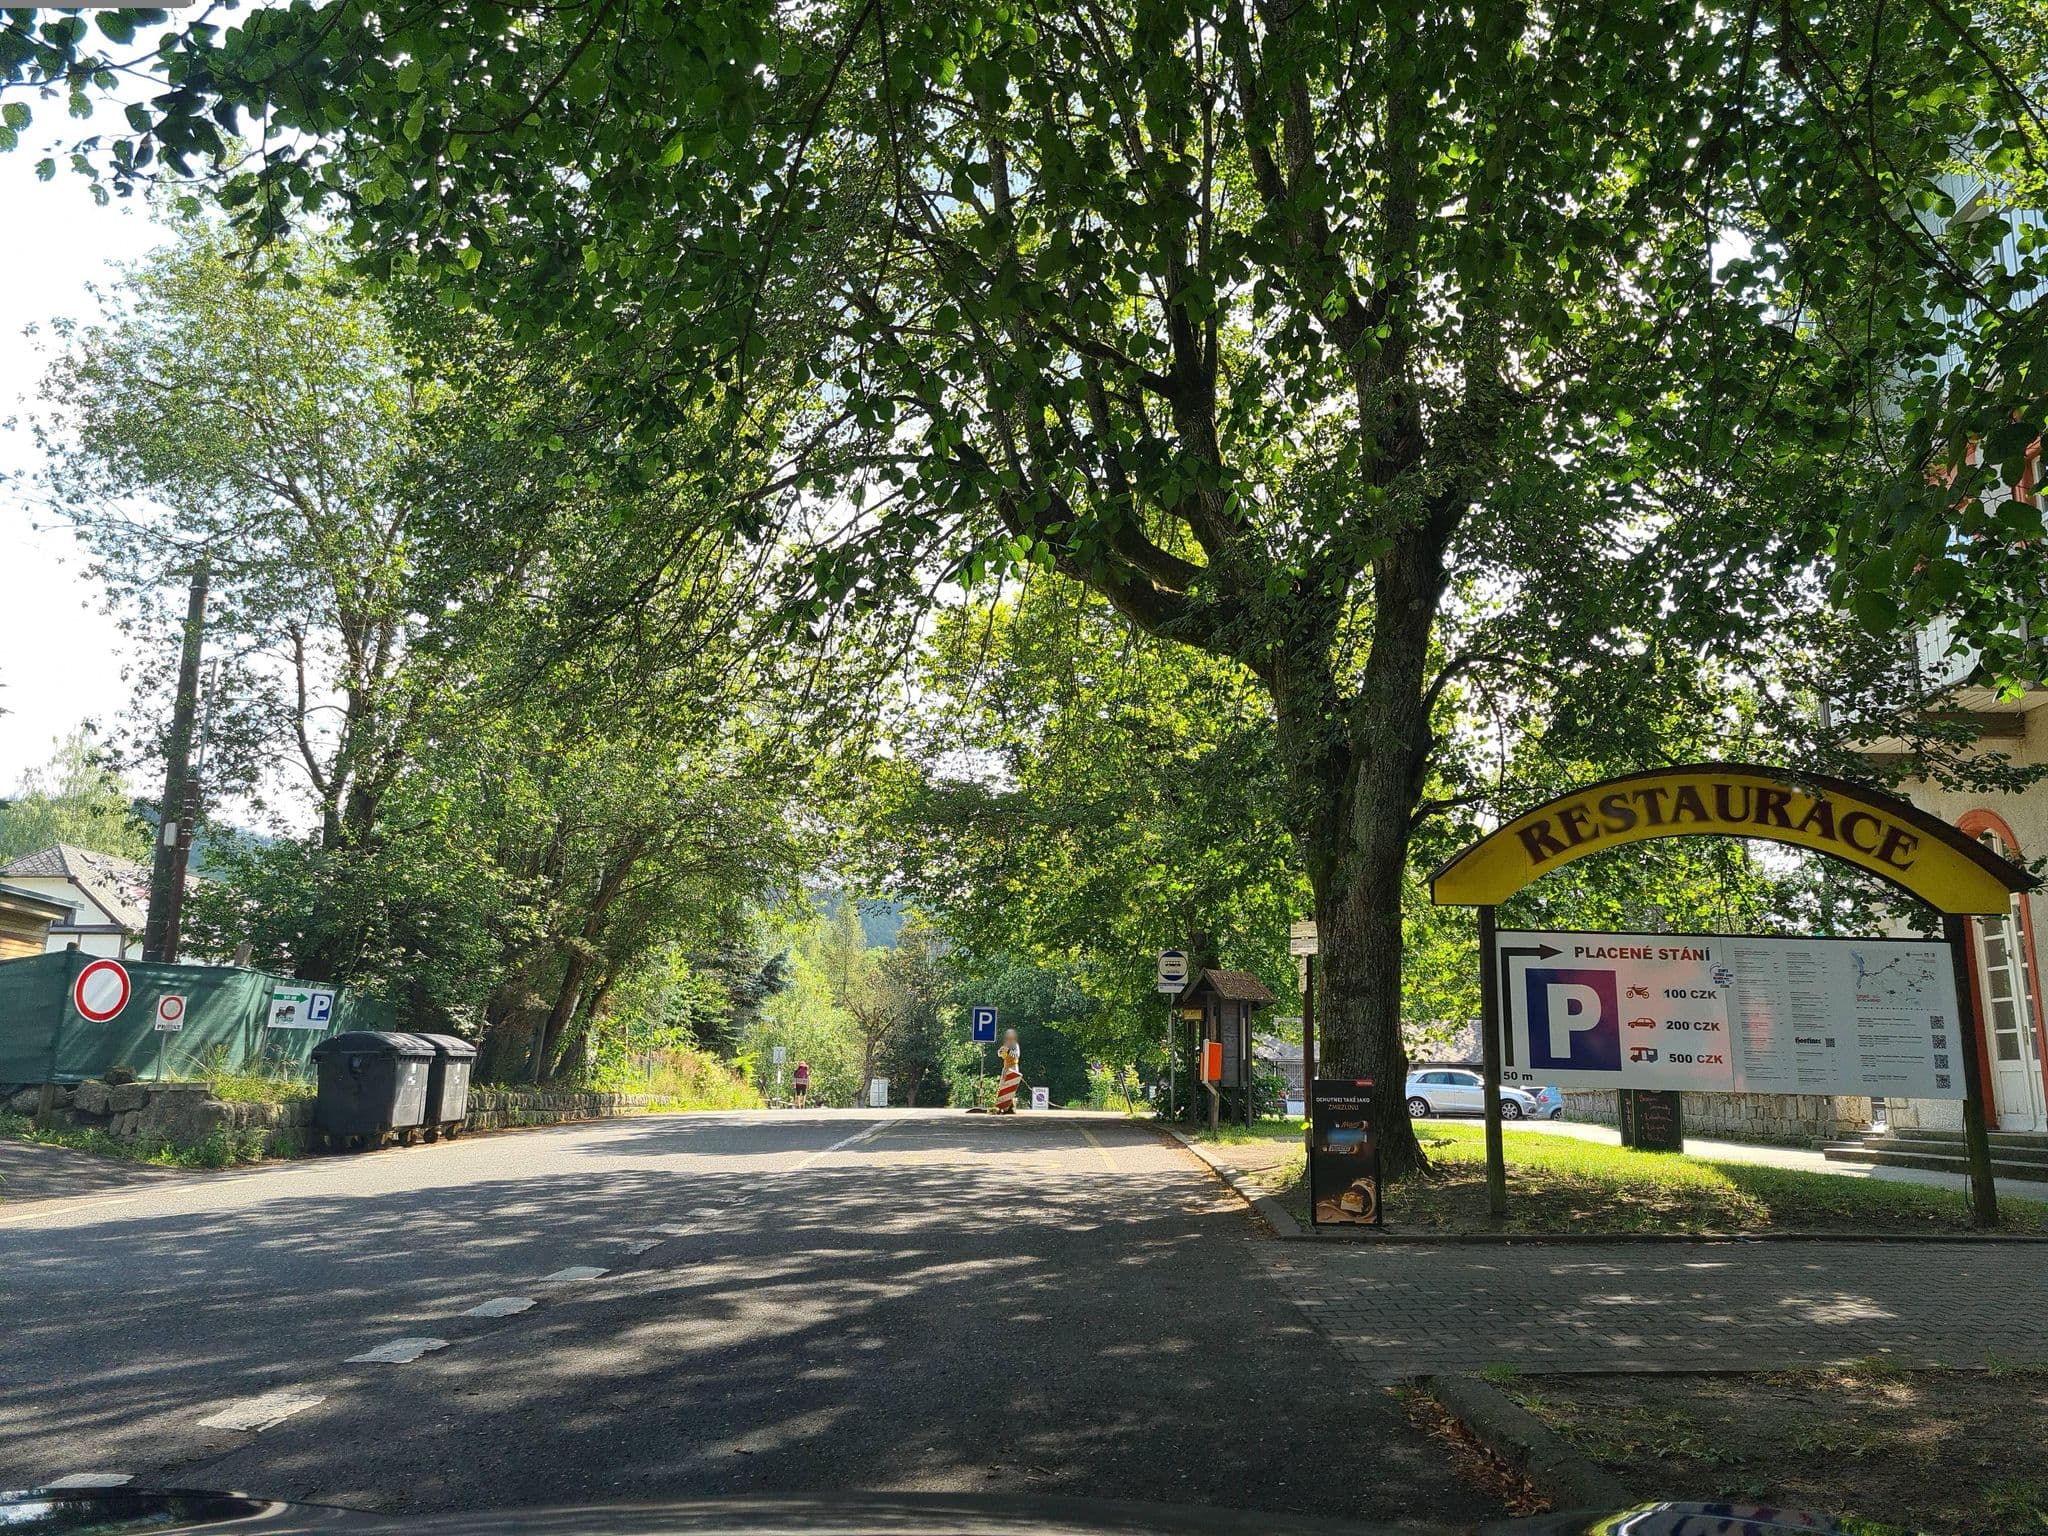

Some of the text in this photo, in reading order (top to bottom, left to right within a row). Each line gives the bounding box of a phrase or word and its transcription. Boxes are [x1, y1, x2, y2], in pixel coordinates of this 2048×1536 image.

[1516, 785, 1921, 872] RESTAURACE
[1574, 946, 1710, 961] PLACENÉ STÁNÍ
[1663, 989, 1718, 1000] 100 CZK
[310, 994, 331, 1019] P
[978, 1011, 993, 1032] P
[1546, 983, 1602, 1059] P
[1666, 1021, 1721, 1031] 200 CZK
[1669, 1053, 1724, 1064] 500 CZK
[1503, 1071, 1533, 1081] 50 m
